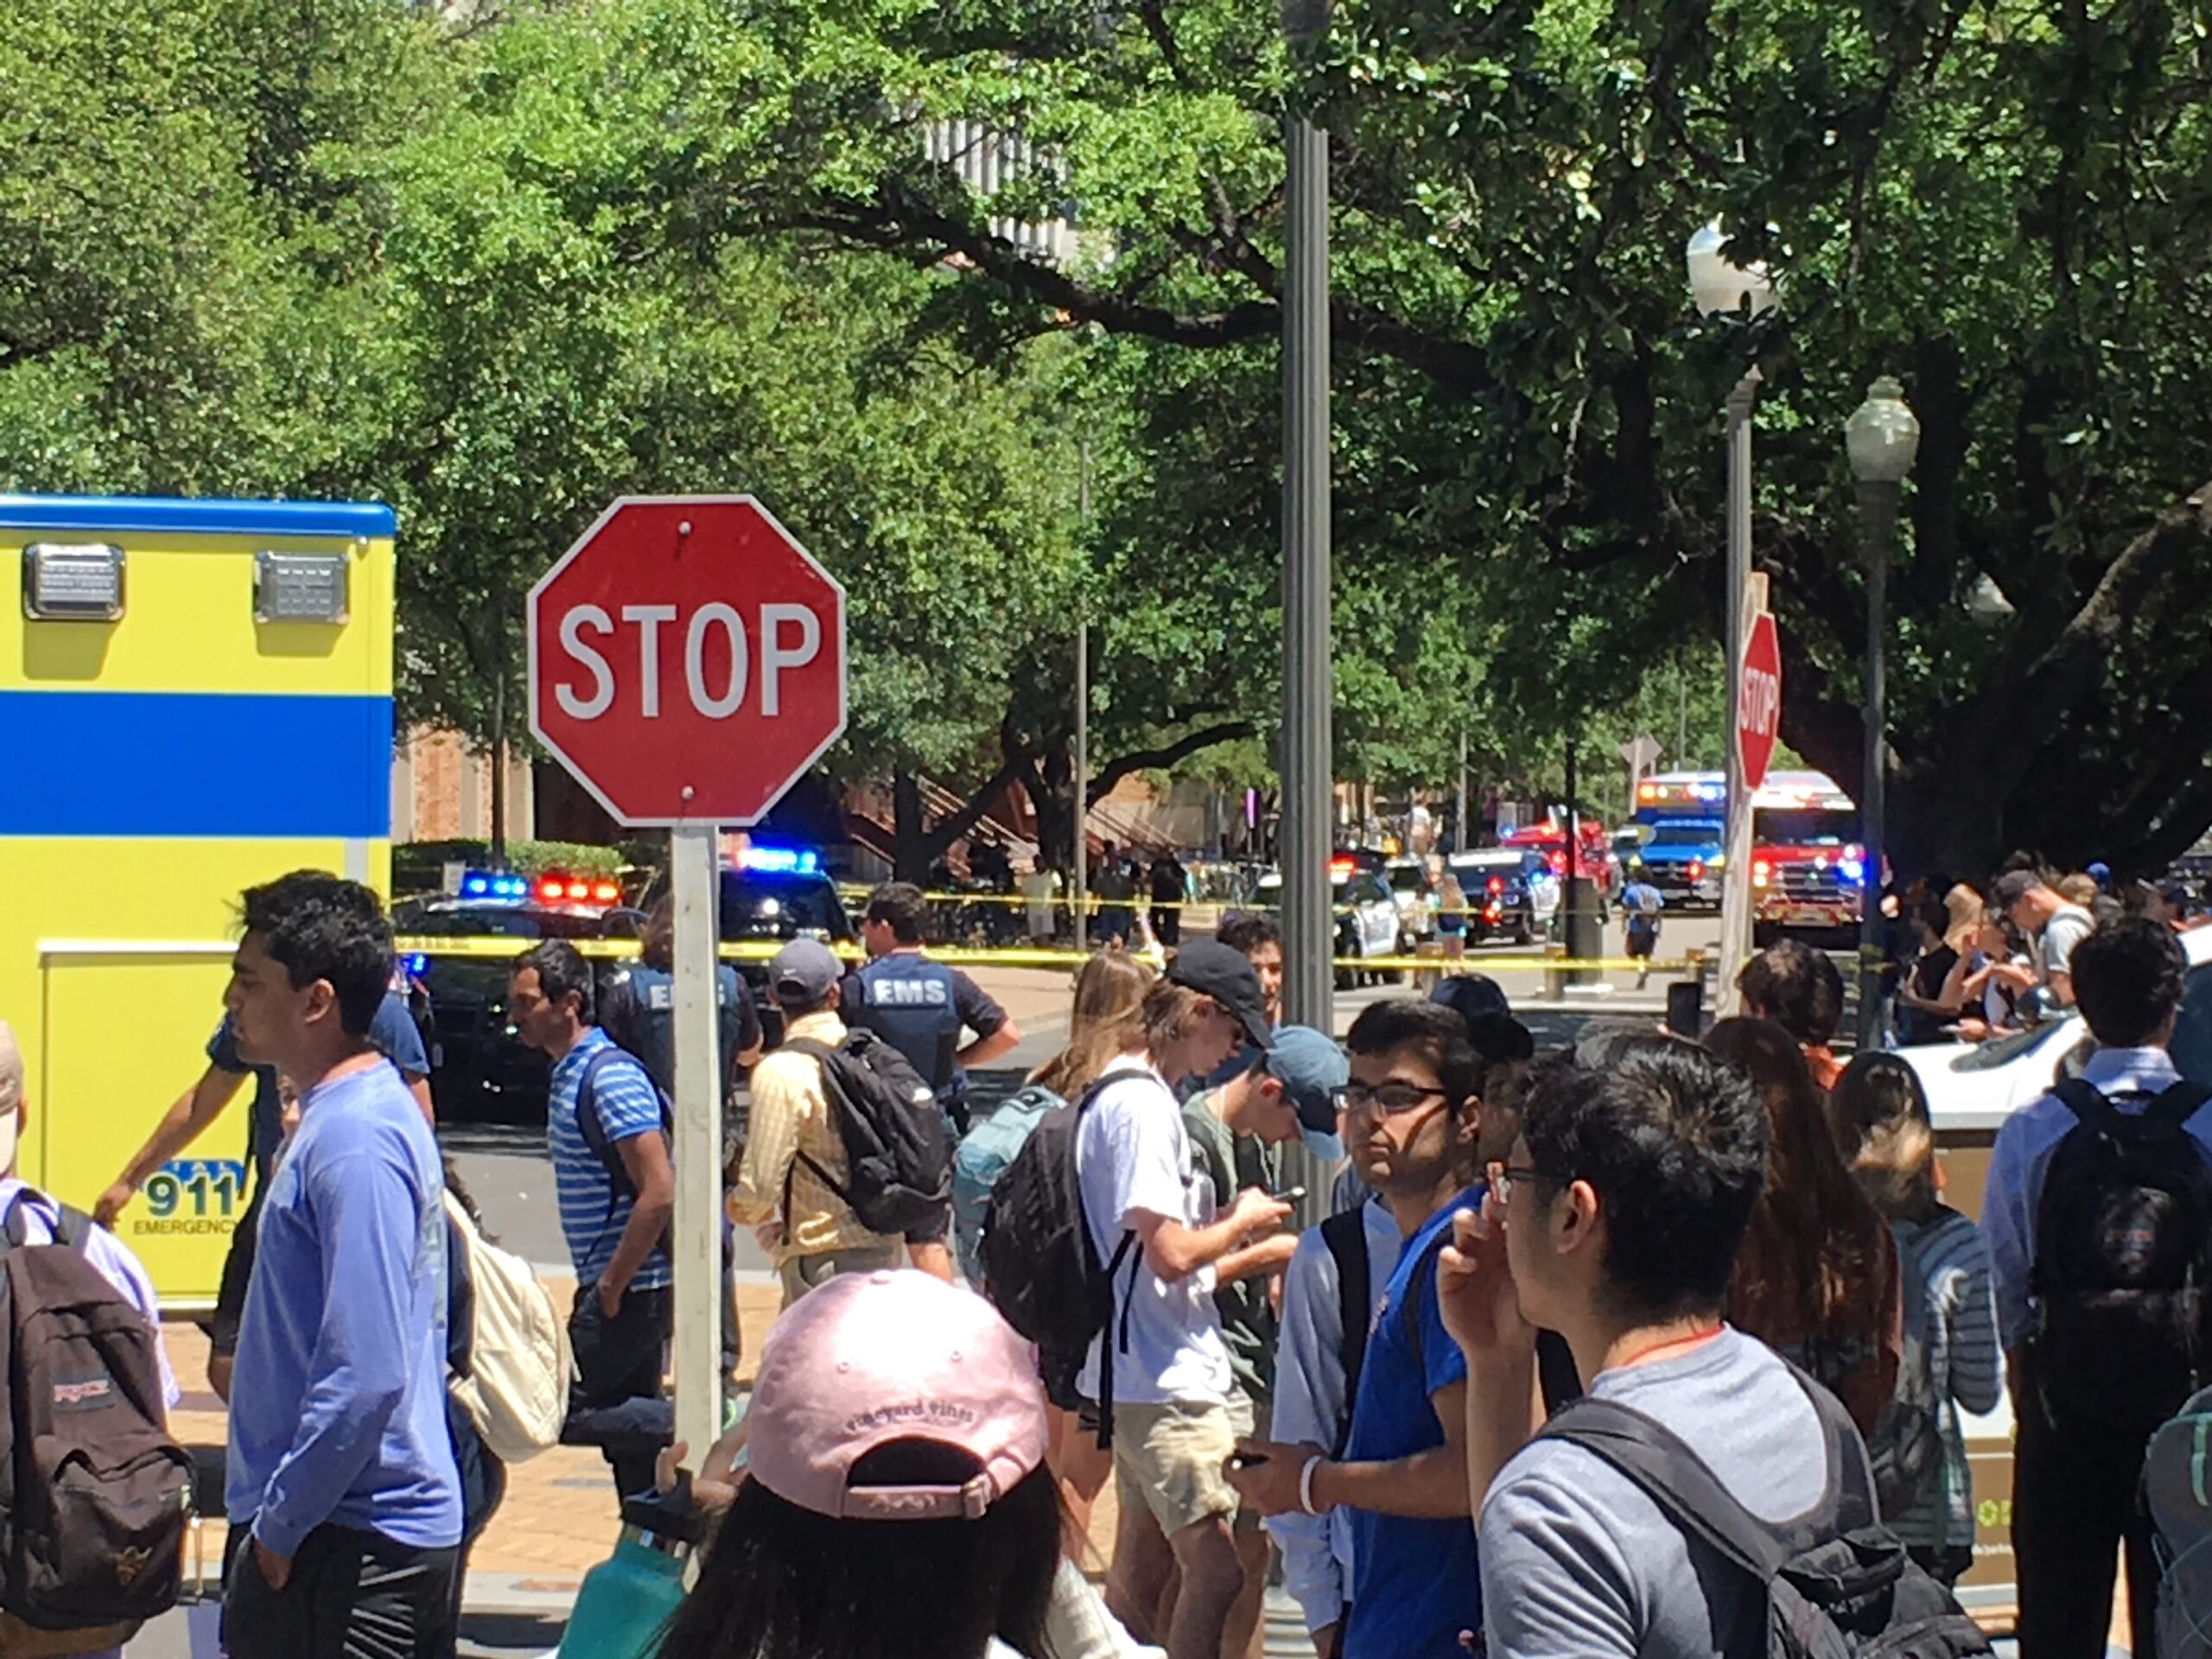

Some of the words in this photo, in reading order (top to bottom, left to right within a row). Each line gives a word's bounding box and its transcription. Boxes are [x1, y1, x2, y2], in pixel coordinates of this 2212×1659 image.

[555, 602, 822, 720] STOP
[1740, 666, 1778, 737] STOP
[874, 979, 947, 1004] EMS
[147, 1174, 232, 1217] 911
